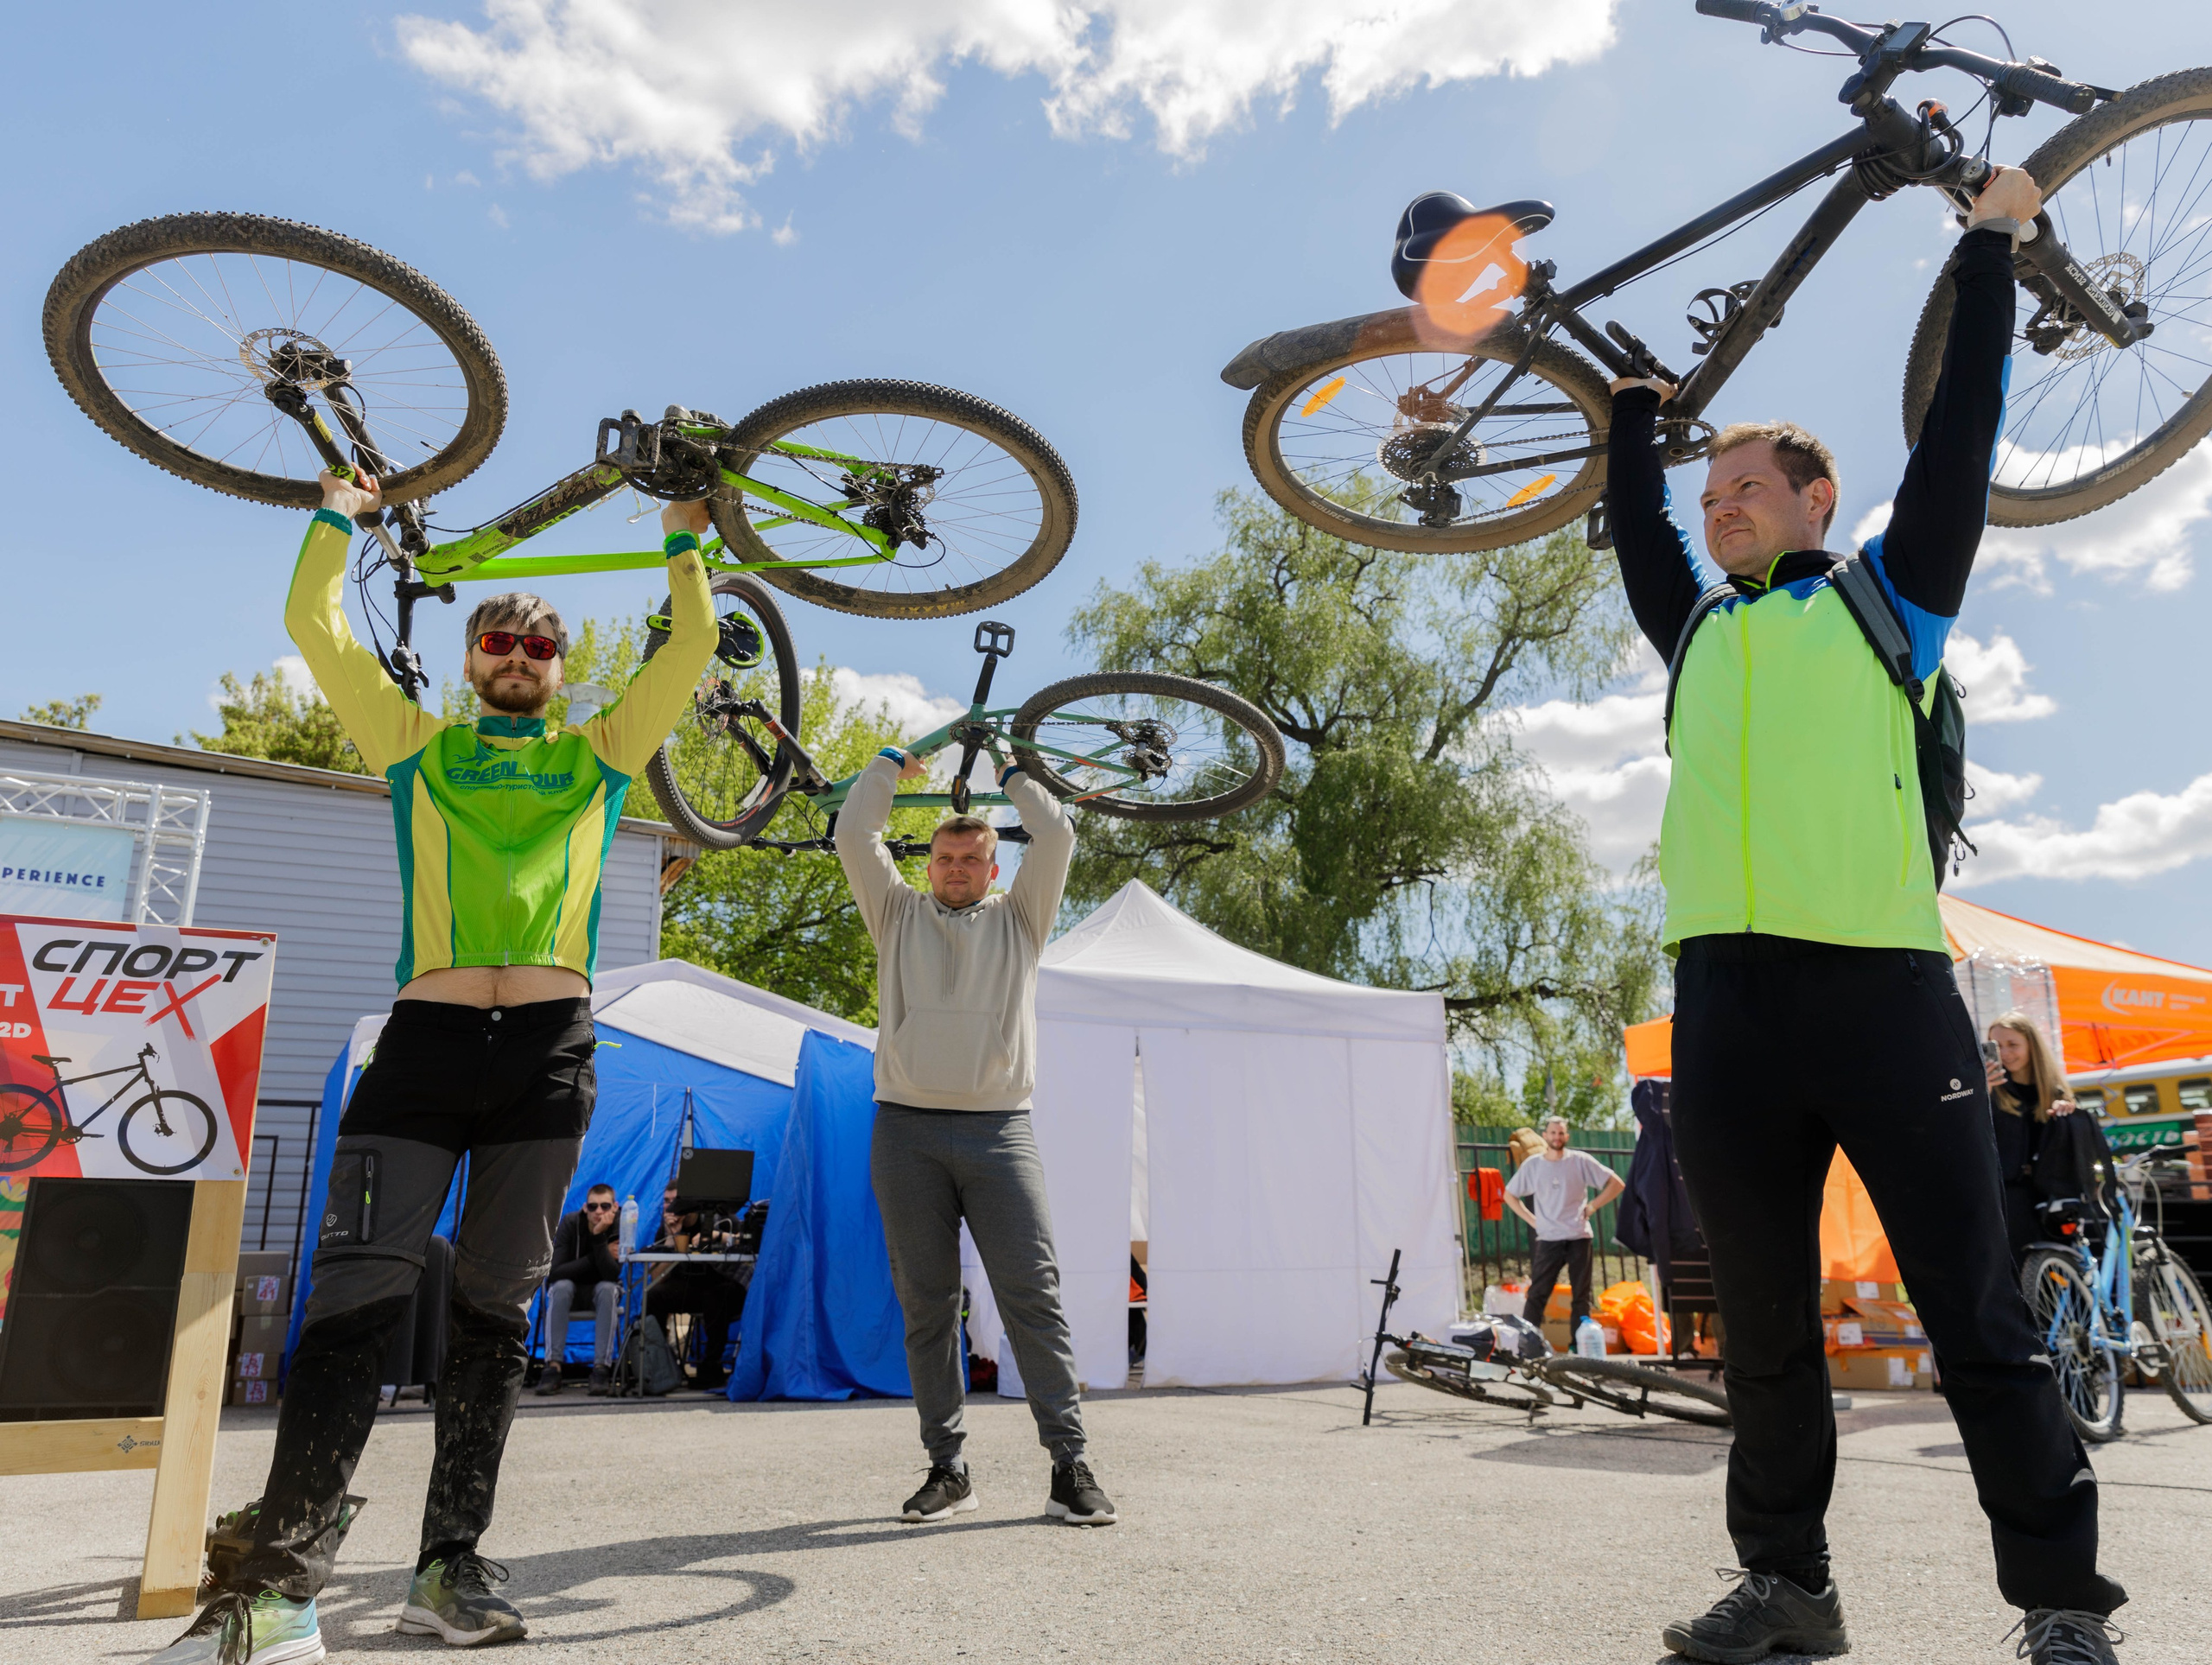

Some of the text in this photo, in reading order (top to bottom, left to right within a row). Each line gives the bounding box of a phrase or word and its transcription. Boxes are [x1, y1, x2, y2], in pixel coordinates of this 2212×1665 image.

[2064, 262, 2088, 286] XCM32
[2095, 444, 2155, 485] SOURCE
[1307, 499, 1353, 524] SOURCE
[446, 760, 518, 782] GREEN
[2, 867, 105, 887] PERIENCE
[32, 938, 264, 983] СПОРТ
[47, 974, 222, 1042] ЦЕХ
[1941, 1088, 1974, 1102] NORDWAY
